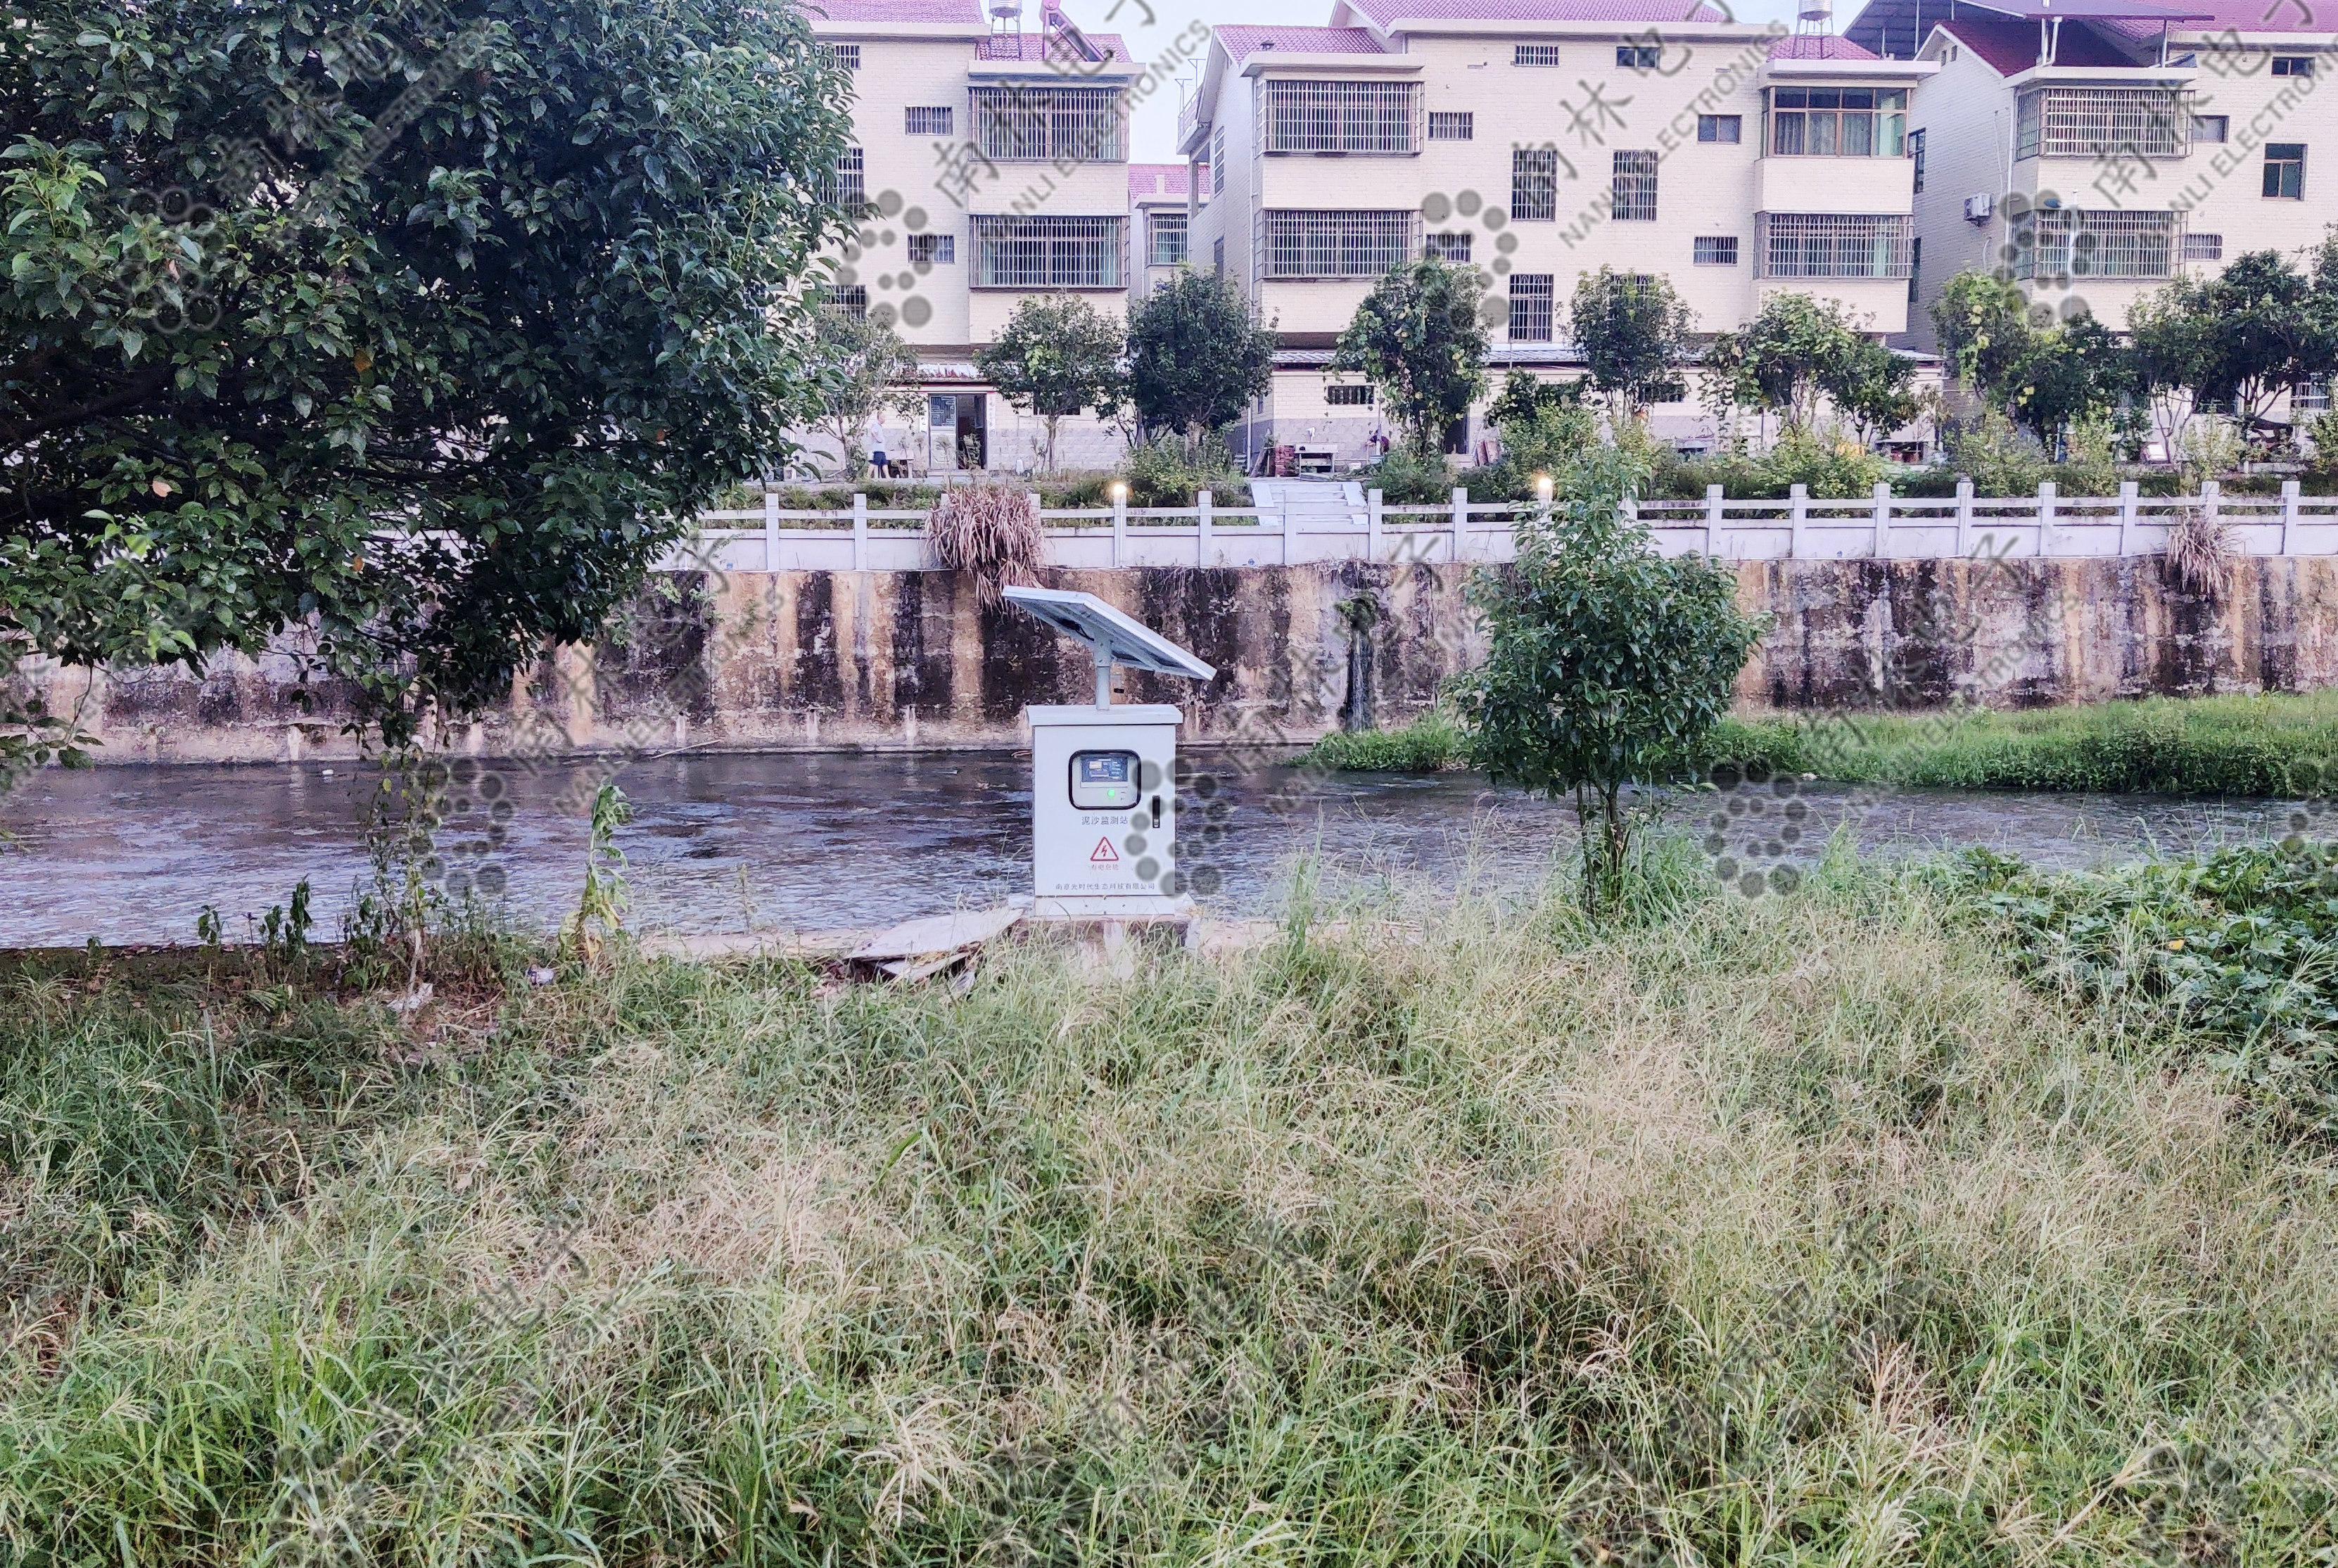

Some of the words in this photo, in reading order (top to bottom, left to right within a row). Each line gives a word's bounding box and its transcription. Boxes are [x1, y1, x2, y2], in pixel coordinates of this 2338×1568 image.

[1081, 815, 1129, 825] 泥沙监测站
